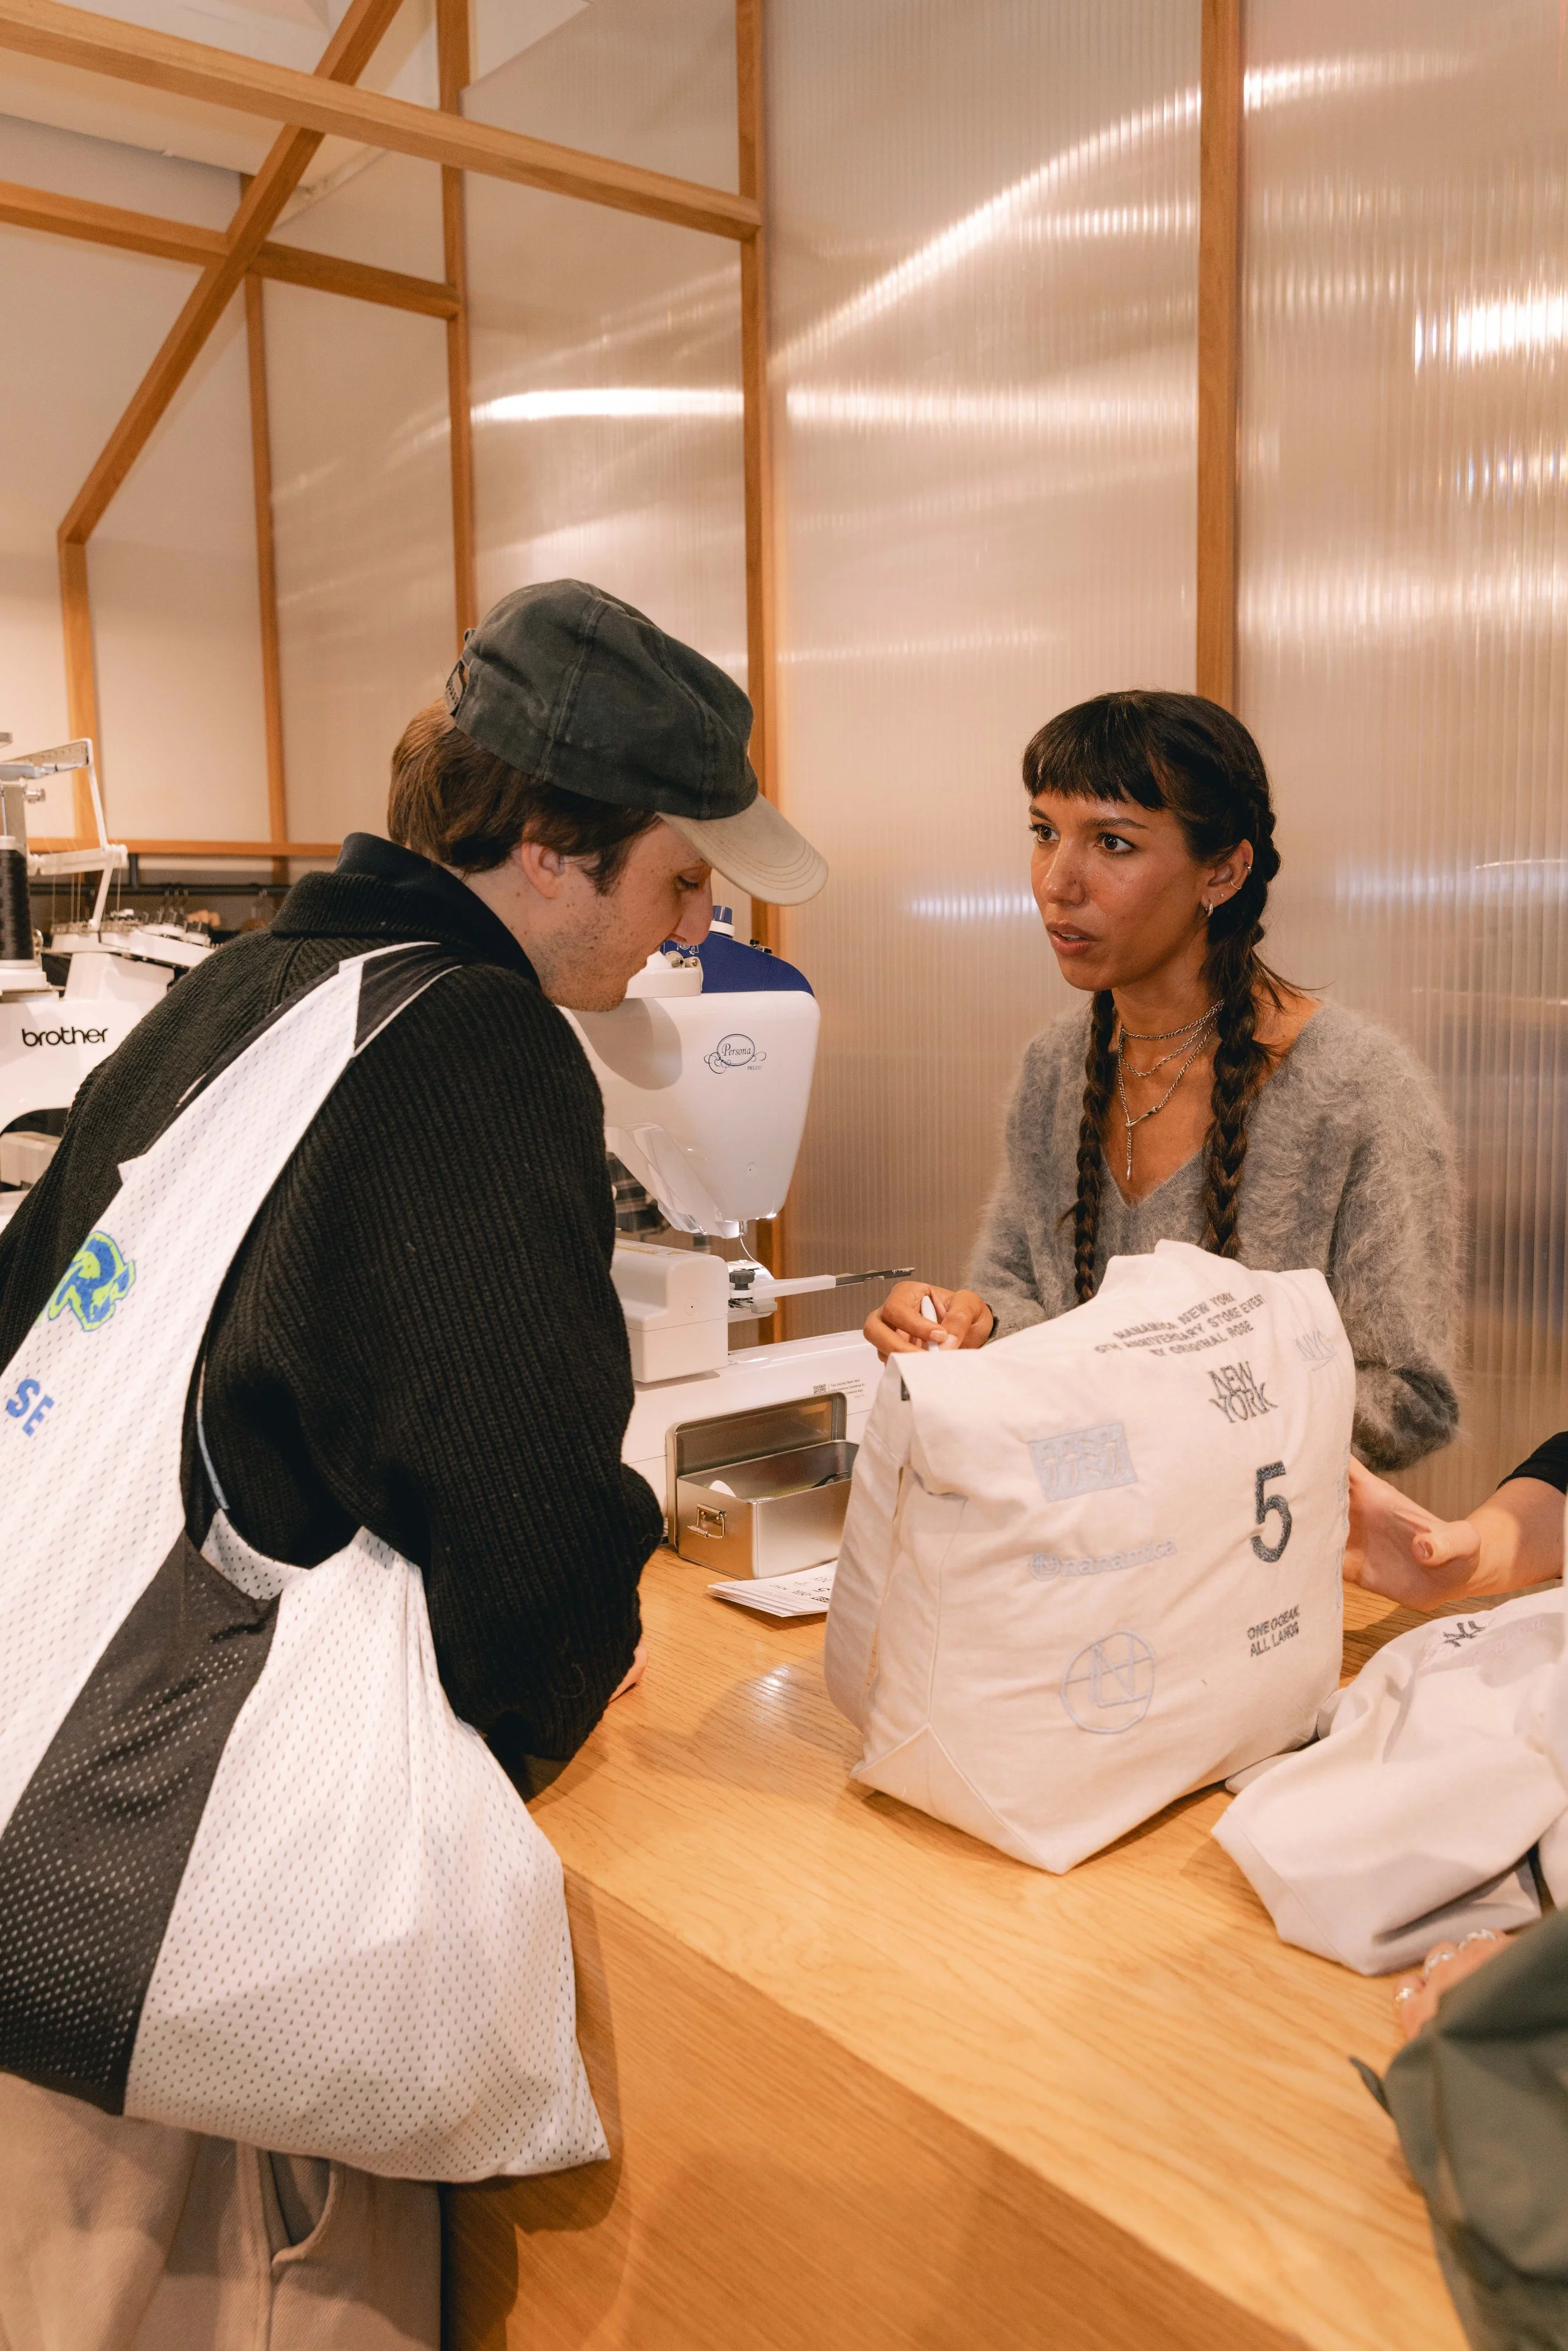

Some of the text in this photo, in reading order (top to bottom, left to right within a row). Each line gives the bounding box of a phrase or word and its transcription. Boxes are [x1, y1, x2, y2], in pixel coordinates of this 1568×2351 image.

[21, 1026, 109, 1047] brother
[722, 1043, 751, 1056] Persona
[1122, 1322, 1205, 1348] ANNIVERSARY
[1206, 1307, 1242, 1328] STORE
[1238, 1293, 1267, 1313] EVENT
[1177, 1301, 1210, 1325] NEW
[1209, 1292, 1237, 1307] YORK
[1168, 1332, 1229, 1354] ORIGINAL
[1226, 1320, 1254, 1339] ROSE
[1207, 1361, 1256, 1399] NEW
[1208, 1382, 1279, 1423] YORK
[1250, 1460, 1292, 1563] 5
[1061, 1539, 1178, 1577] nanamica
[1246, 1604, 1300, 1640] ONE OCEAN
[1250, 1621, 1300, 1657] ALL LANDS
